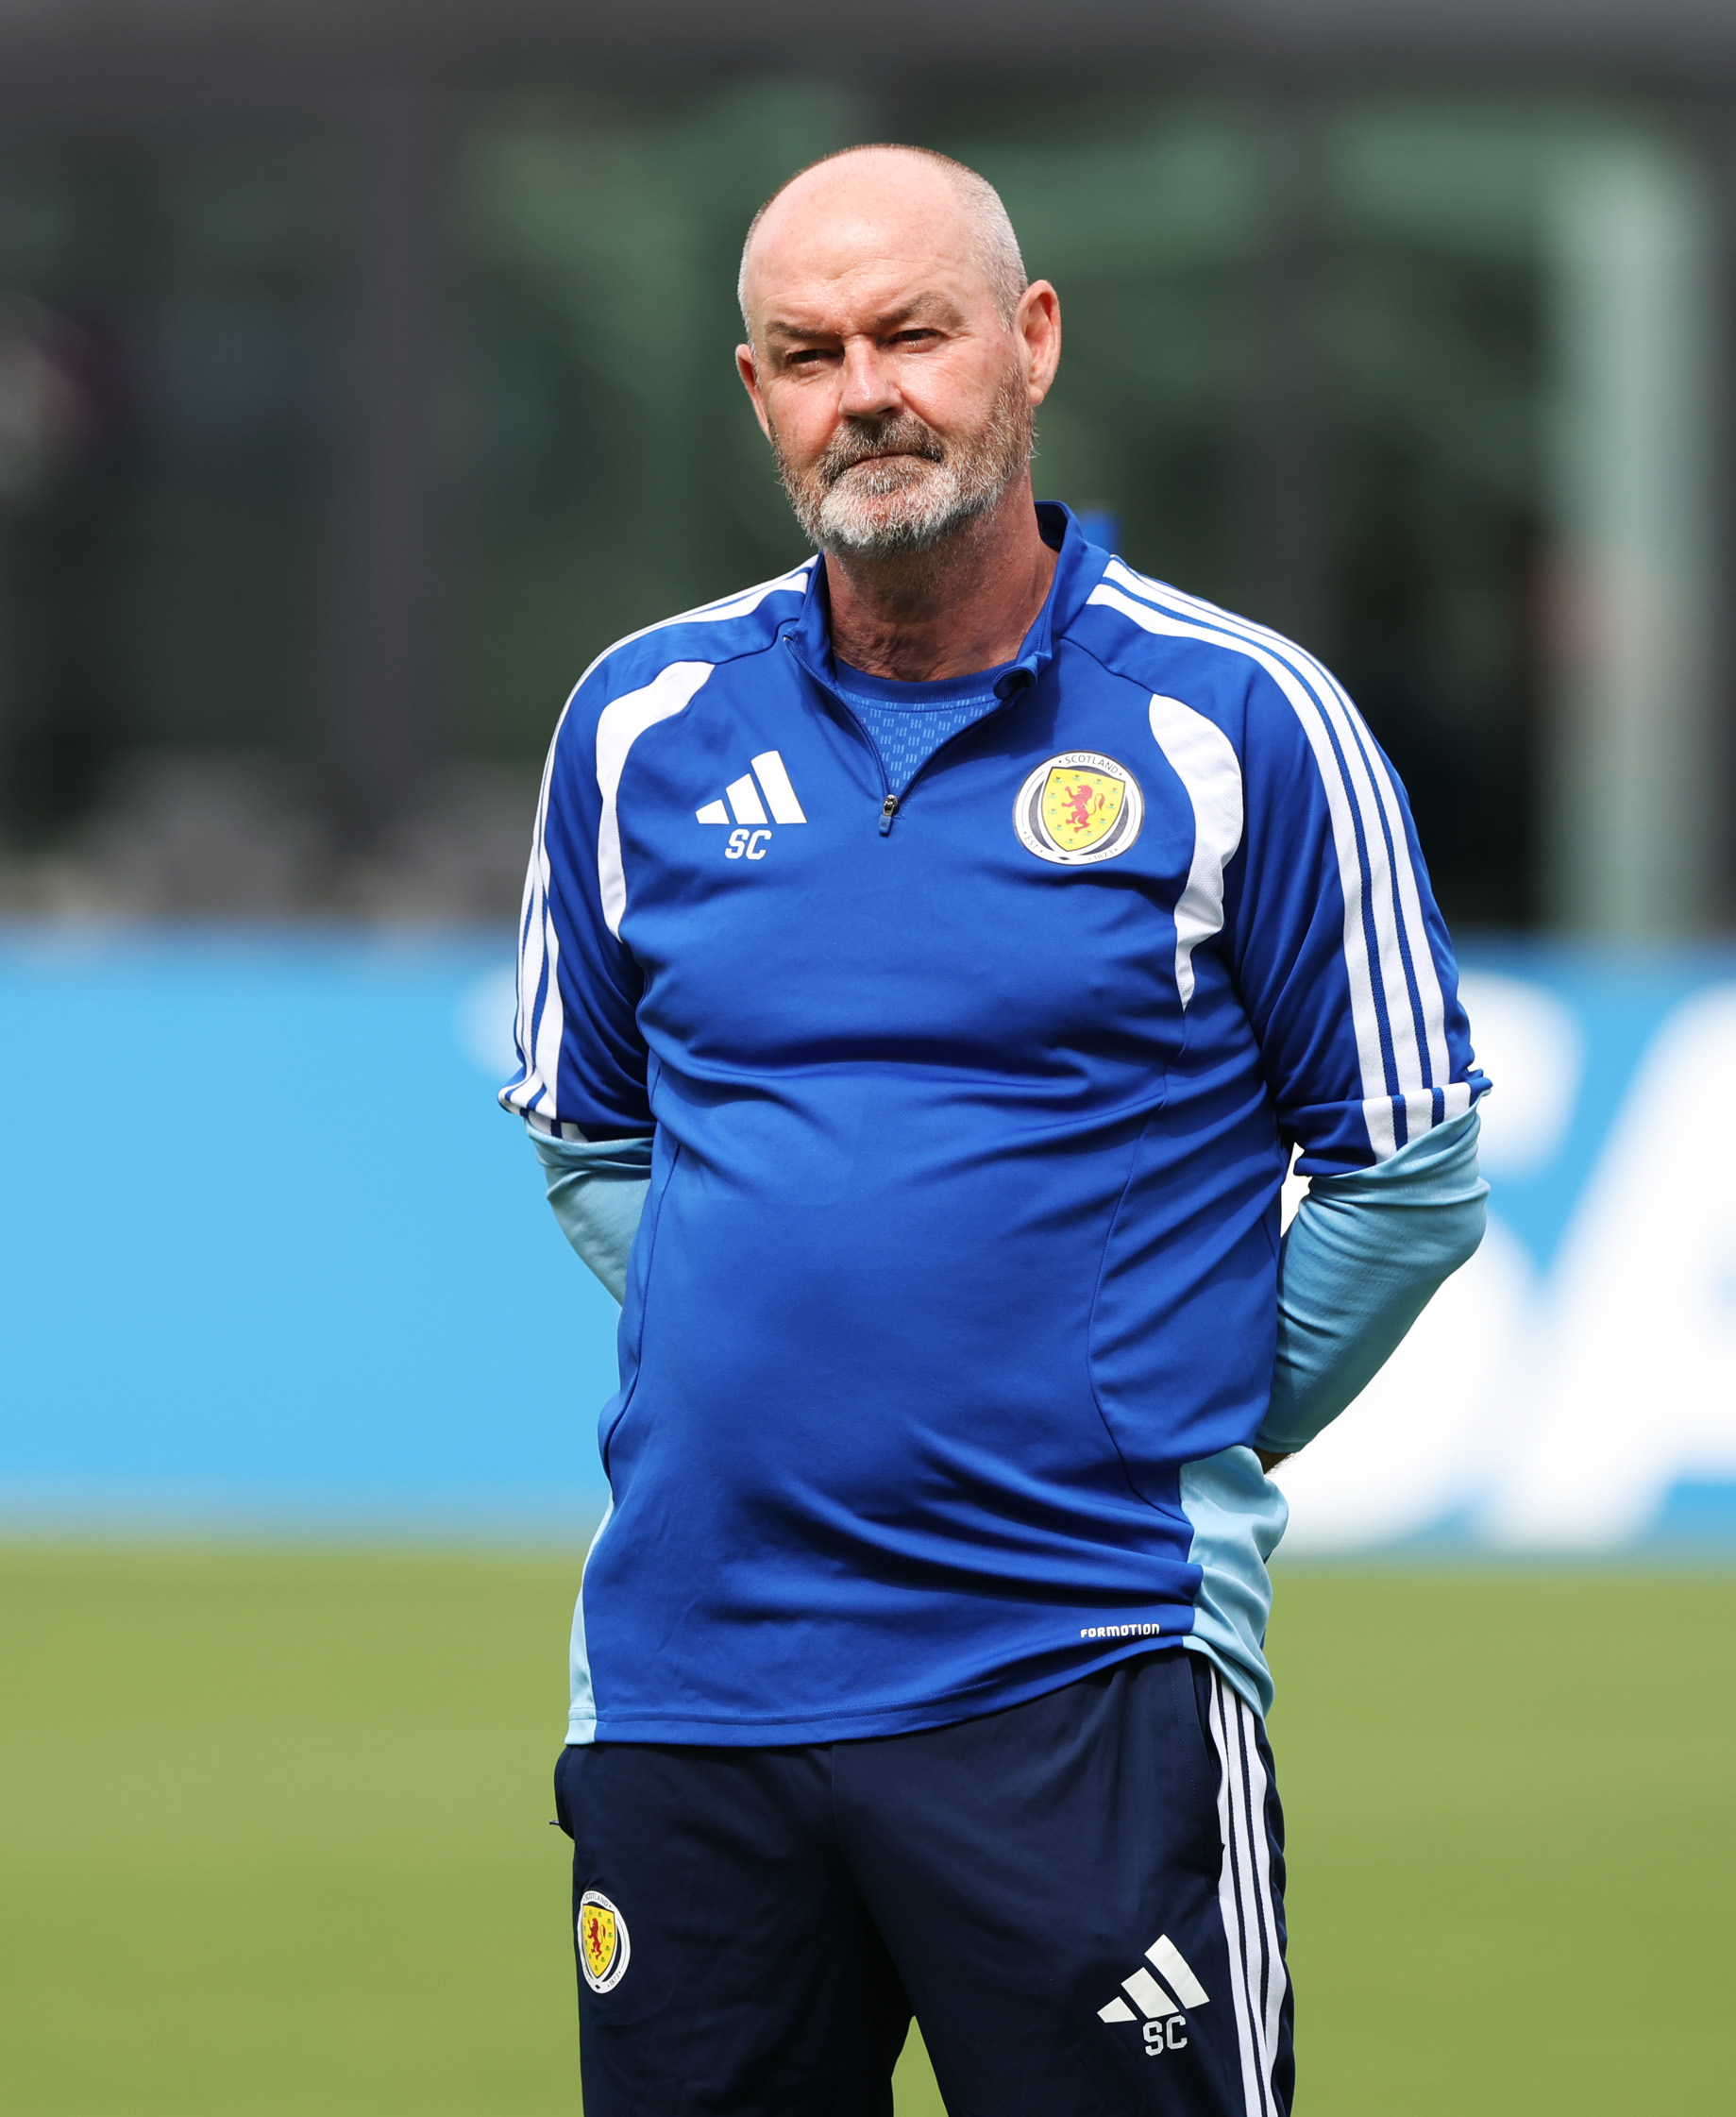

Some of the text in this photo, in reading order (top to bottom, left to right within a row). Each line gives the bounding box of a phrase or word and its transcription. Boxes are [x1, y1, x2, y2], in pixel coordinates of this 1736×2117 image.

[1065, 754, 1119, 774] SCOTLAND
[725, 828, 772, 860] SC
[1024, 835, 1039, 849] EST
[1080, 1623, 1160, 1638] FORMOTION
[584, 1892, 609, 1907] SCOTLAND
[1142, 2014, 1188, 2057] SC
